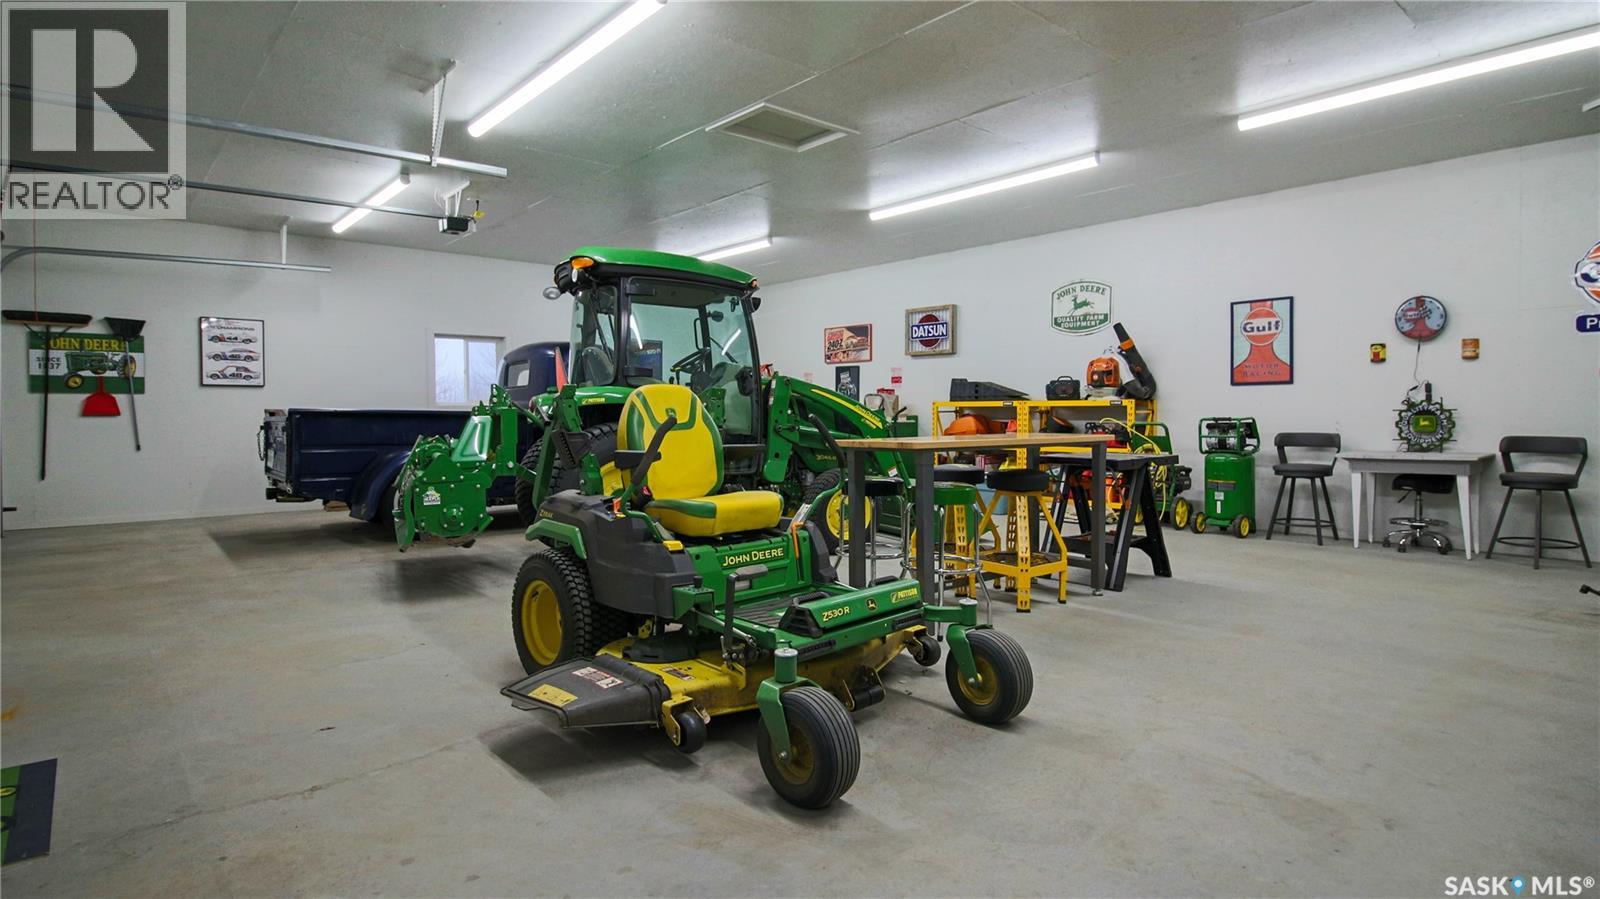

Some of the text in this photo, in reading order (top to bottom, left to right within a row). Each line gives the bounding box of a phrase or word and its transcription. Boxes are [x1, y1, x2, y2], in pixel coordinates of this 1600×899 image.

[1056, 284, 1106, 300] JOHN DEERE
[1056, 313, 1105, 323] QUALITY FARM
[1061, 320, 1100, 329] EQUIPMENT
[912, 323, 947, 338] DATSUN
[1242, 320, 1281, 333] Gulf
[38, 362, 60, 370] 137
[723, 548, 784, 566] JOHN DEERE
